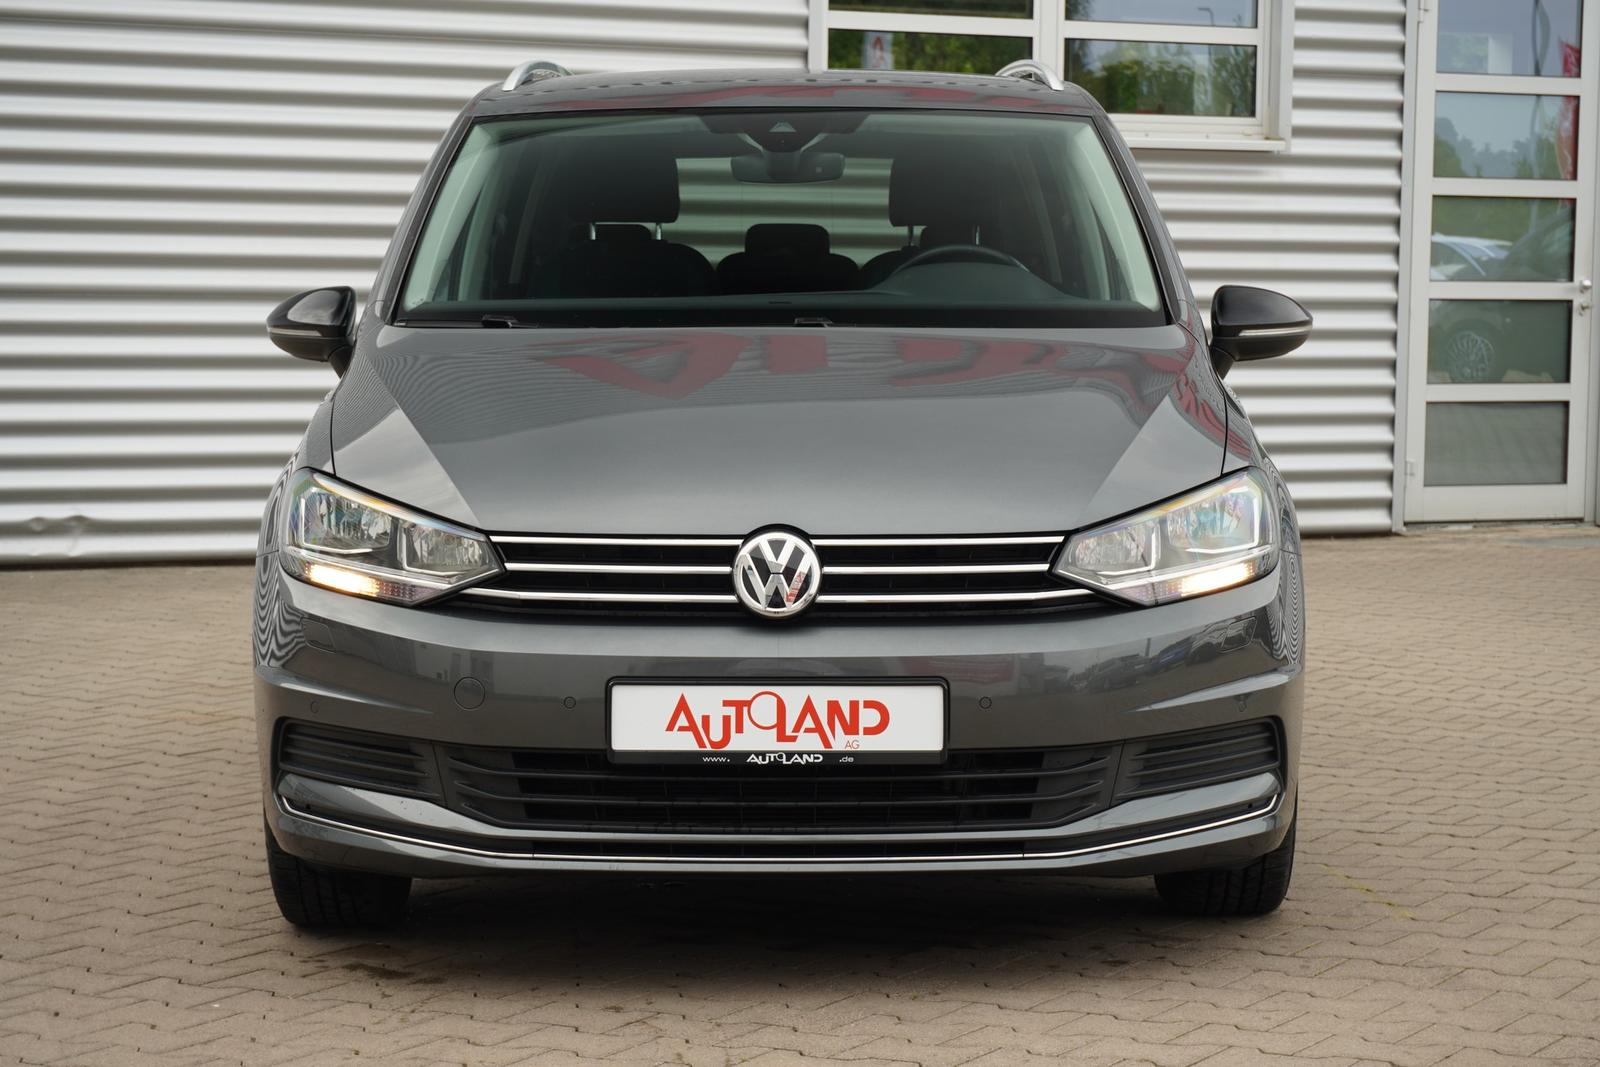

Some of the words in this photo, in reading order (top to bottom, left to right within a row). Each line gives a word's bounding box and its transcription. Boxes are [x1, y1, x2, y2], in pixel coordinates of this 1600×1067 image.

[665, 690, 891, 750] AUTOLAND
[844, 739, 860, 750] AG
[702, 755, 731, 763] www.
[746, 751, 824, 765] AUTOLAND
[838, 754, 855, 763] .de
